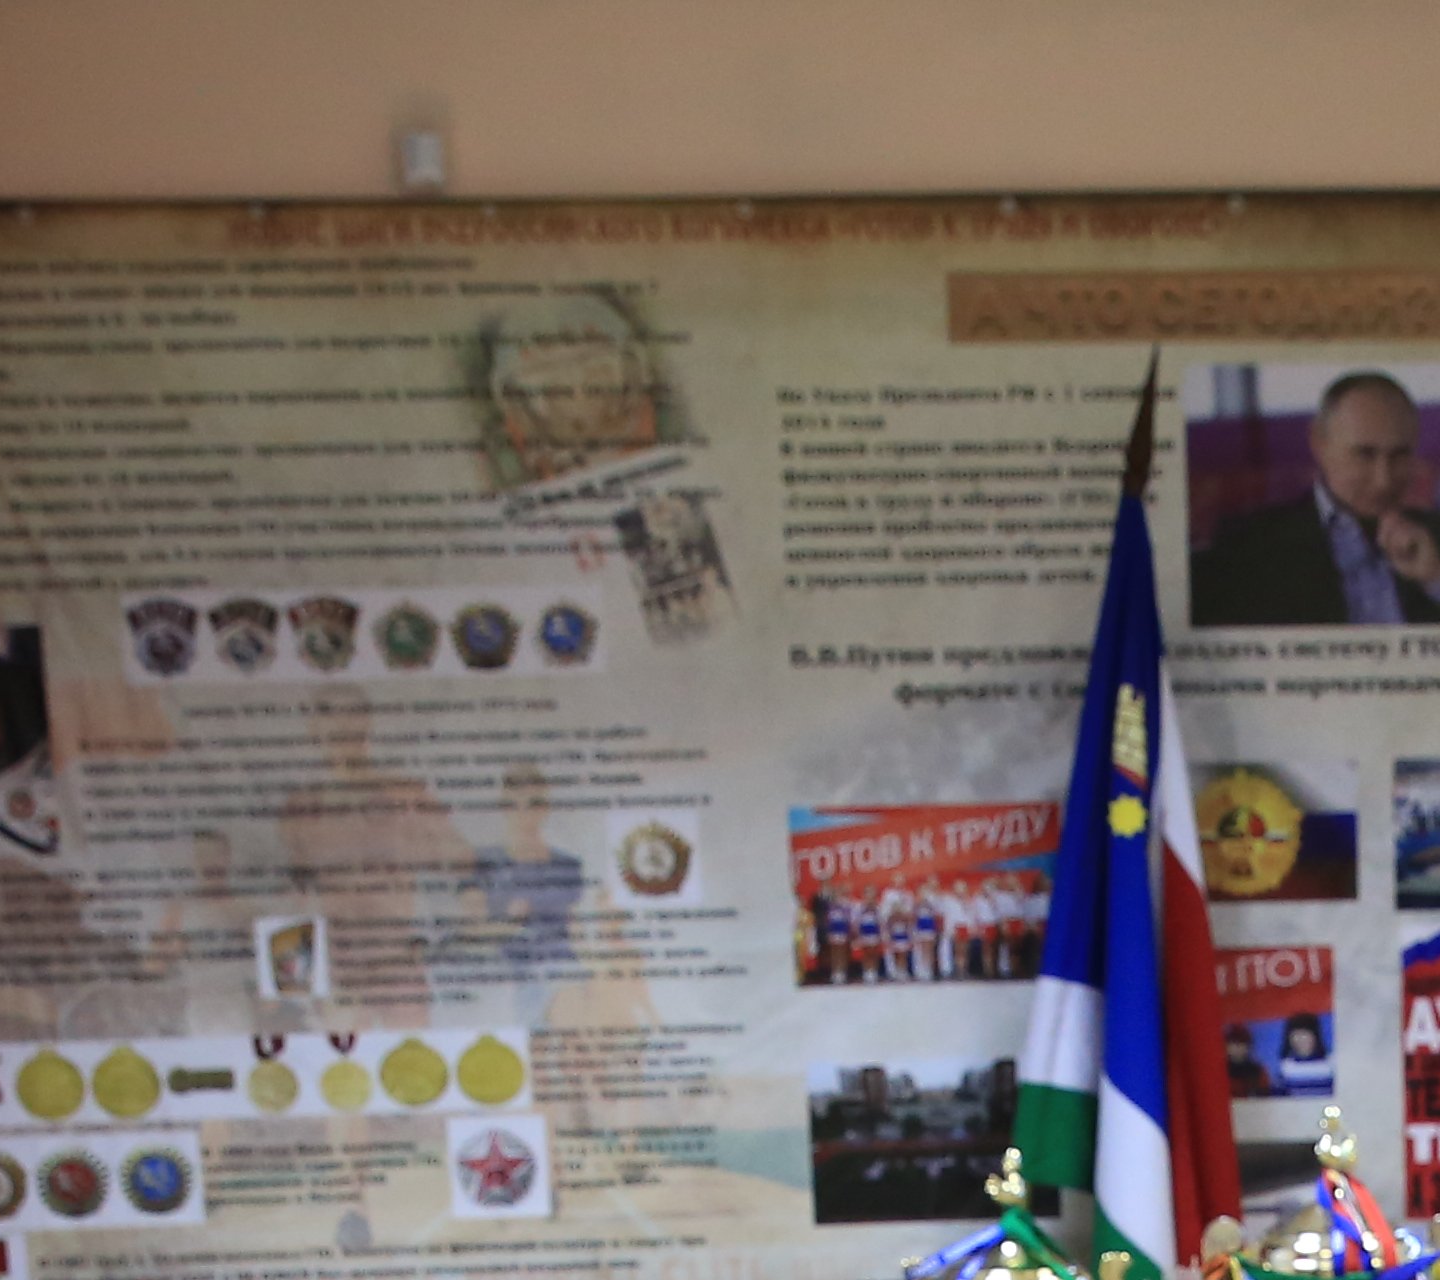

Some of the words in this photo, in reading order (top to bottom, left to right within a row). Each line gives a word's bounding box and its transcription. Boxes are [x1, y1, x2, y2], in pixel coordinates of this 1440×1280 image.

[795, 833, 903, 886] ГОТОВ
[910, 820, 934, 861] К
[944, 803, 1050, 850] ТРУДУ
